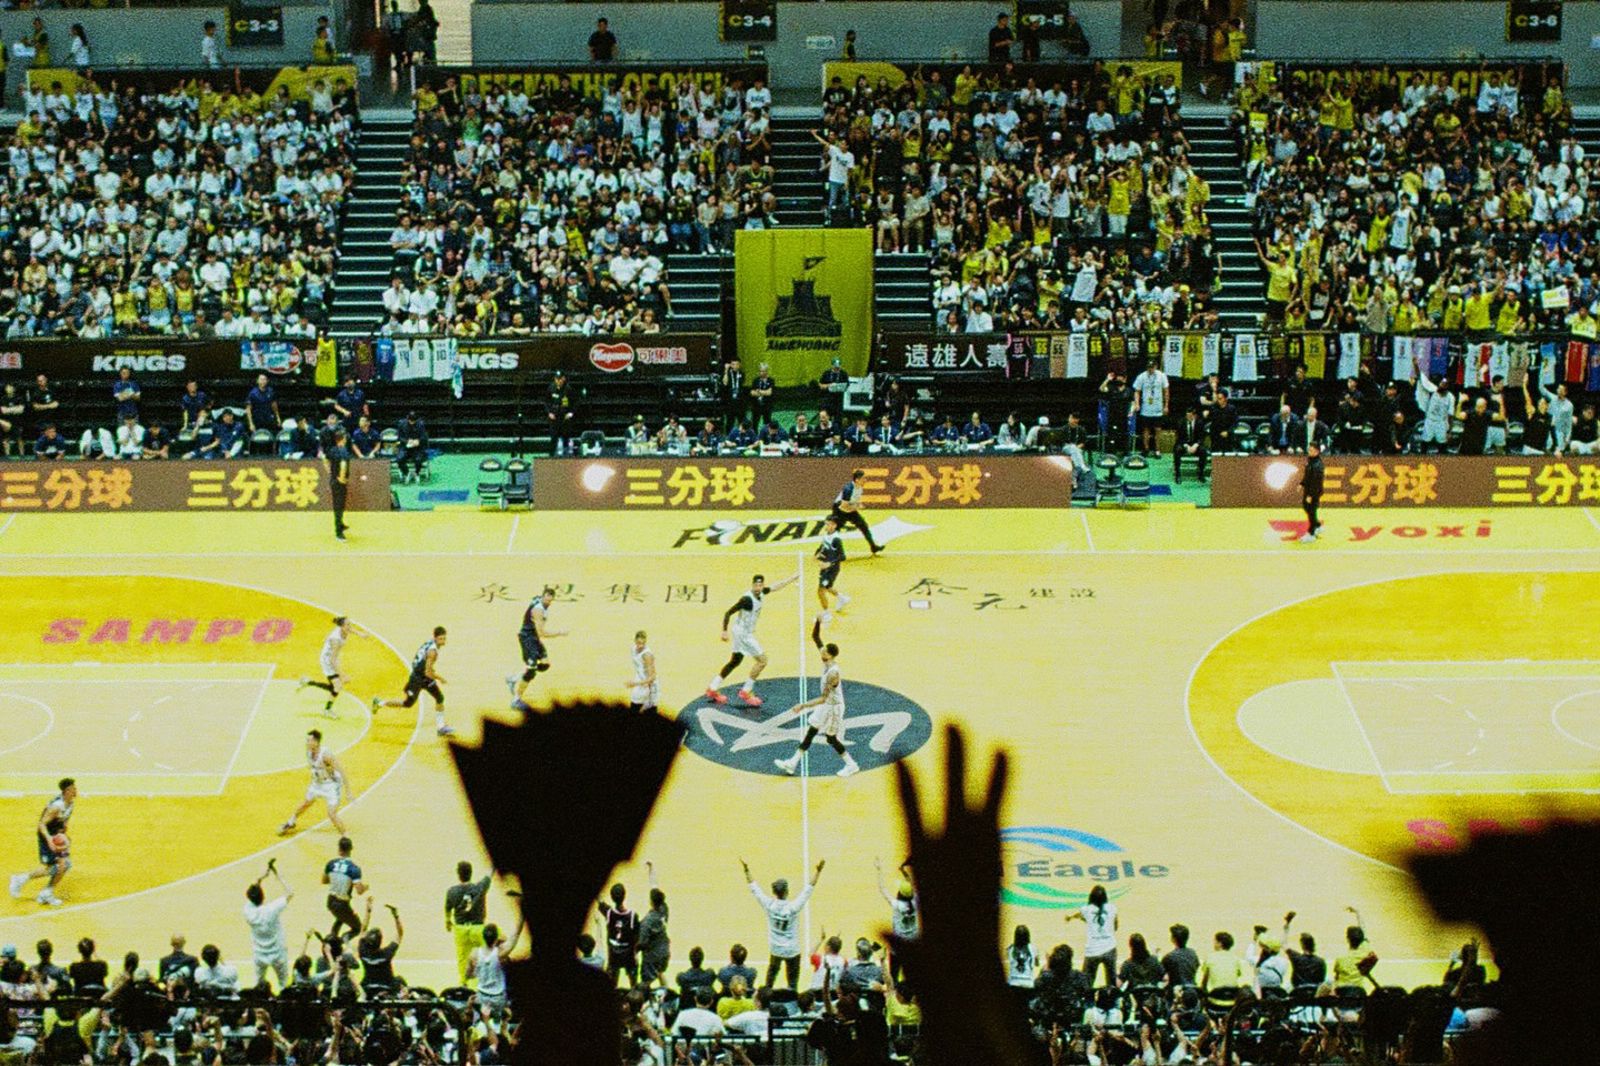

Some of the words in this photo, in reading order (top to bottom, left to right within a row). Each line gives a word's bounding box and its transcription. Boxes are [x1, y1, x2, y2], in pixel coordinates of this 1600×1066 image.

[234, 19, 279, 32] C3-3
[729, 15, 772, 27] C3-4
[1515, 15, 1558, 27] C3-6
[92, 354, 186, 371] KINGS
[459, 353, 520, 369] NGS
[905, 344, 1008, 368] 遠雄人壽
[2, 468, 133, 508] 三分球
[187, 467, 320, 507] 三分球
[624, 464, 755, 506] 三分球
[853, 464, 982, 505] 三分球
[1319, 463, 1439, 504] 三分球
[1347, 519, 1493, 541] yoxi
[42, 618, 293, 643] SAMPO
[1017, 859, 1170, 882] Eagle
